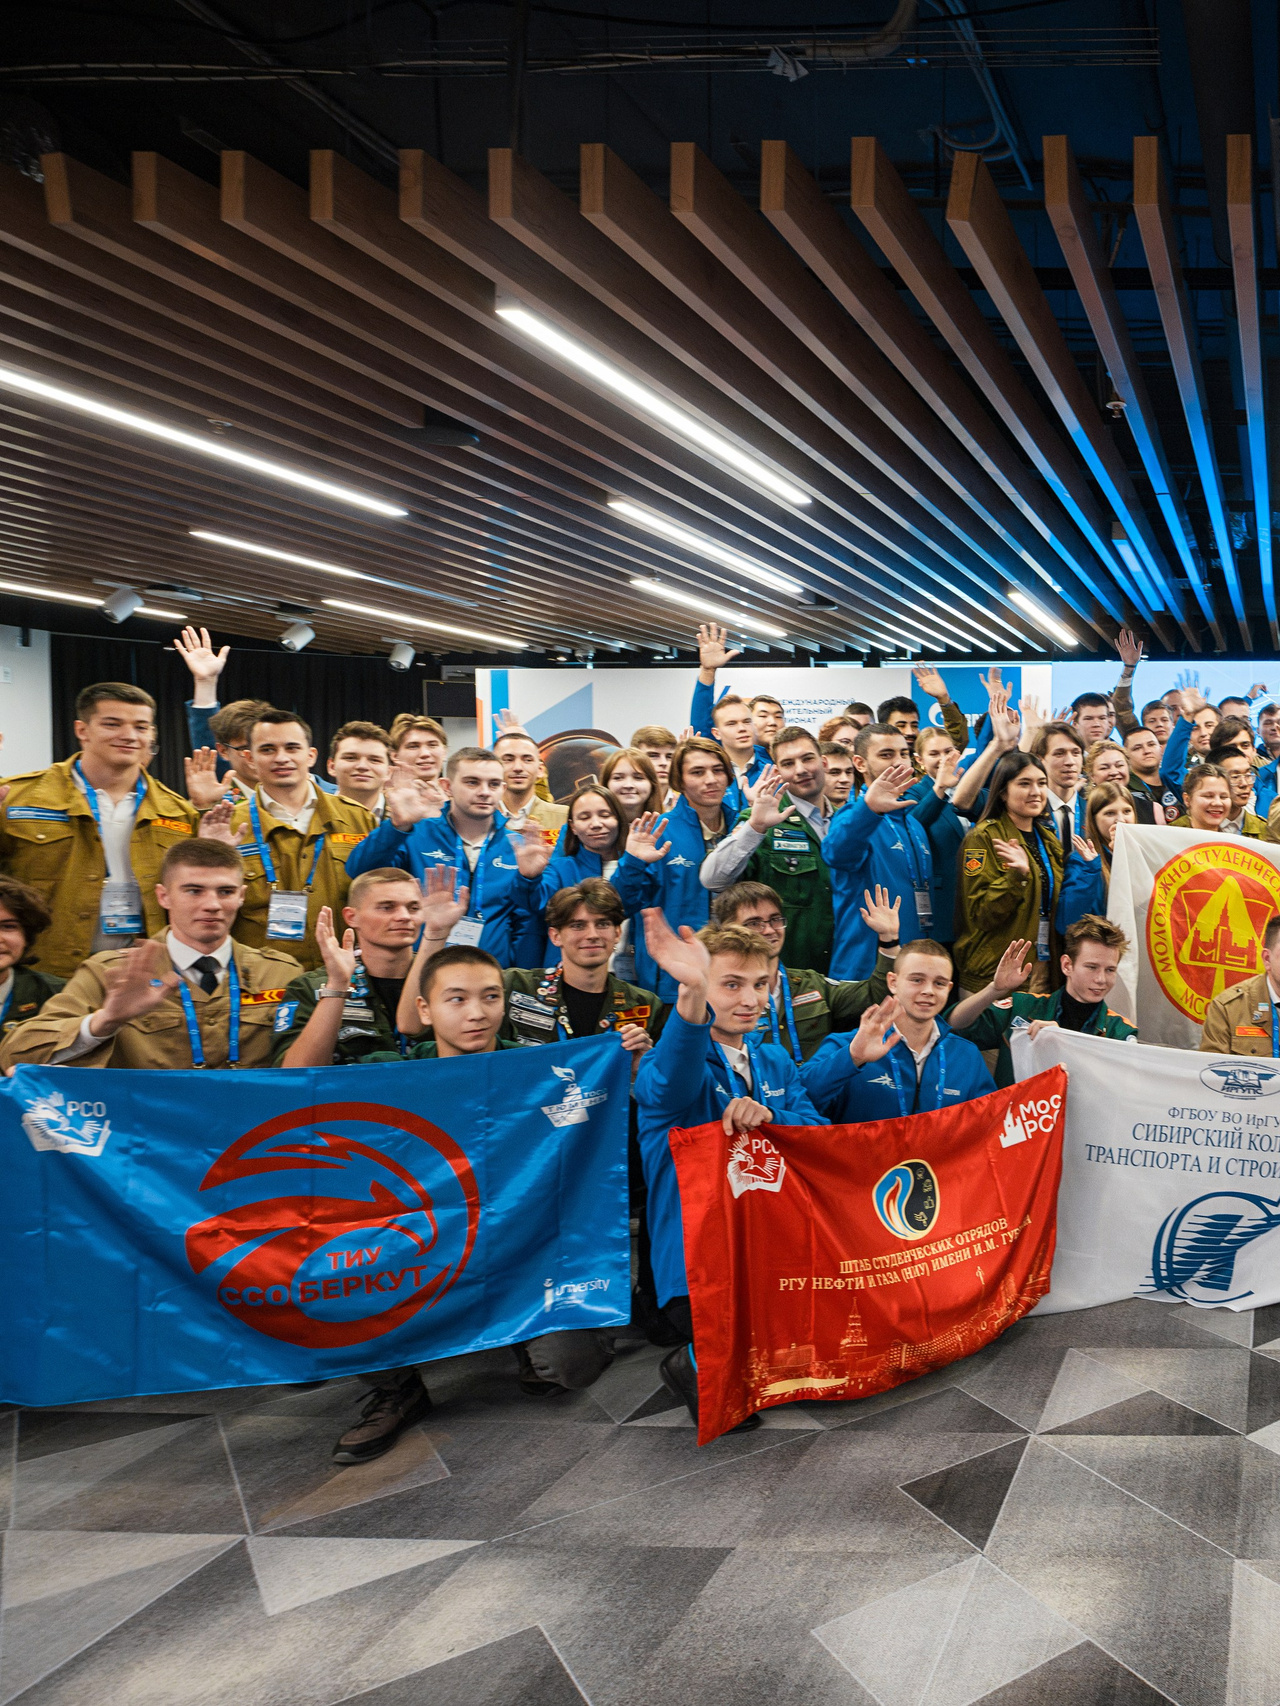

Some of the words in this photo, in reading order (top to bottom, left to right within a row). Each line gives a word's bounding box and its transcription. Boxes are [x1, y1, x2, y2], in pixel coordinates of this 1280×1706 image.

[779, 698, 855, 706] ЕЖДУНАРОДНЫЙ
[784, 706, 832, 715] ИТЕЛЬНЫЙ
[66, 1100, 107, 1118] РСО
[1167, 1106, 1219, 1122] ФГБОУ
[1221, 1110, 1243, 1125] ВО
[1131, 1122, 1243, 1150] СИБИРСКИЙ
[1084, 1143, 1203, 1173] ТРАНСПОРТА
[1208, 1156, 1221, 1175] И
[325, 1246, 383, 1271] ТИУ
[839, 1258, 872, 1275] ШТАБ
[872, 1237, 953, 1270] СТУДЕНЧЕСКИХ
[954, 1217, 1009, 1246] ОТРЯДОВ
[778, 1278, 807, 1291] РГУ
[811, 1276, 866, 1291] НЕФТИ
[867, 1275, 877, 1288] И
[877, 1271, 902, 1287] ГАЗА
[900, 1263, 931, 1284] (НИУ)
[931, 1247, 972, 1272] ИМЕНИ
[973, 1237, 1000, 1256] И.М.
[219, 1284, 290, 1307] ССО
[299, 1265, 428, 1304] БЕРКУТ
